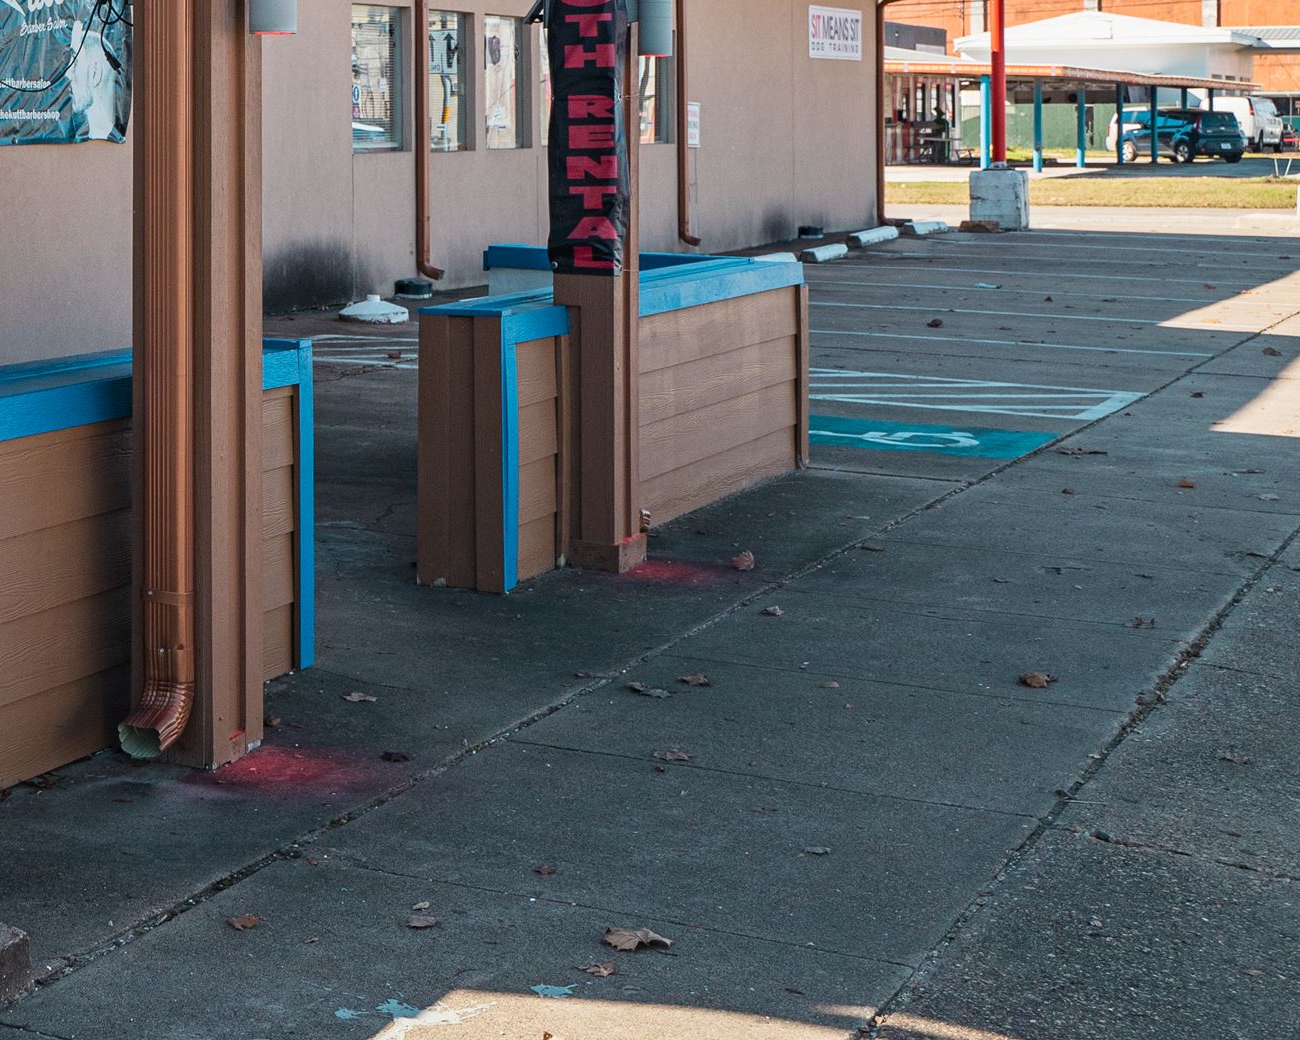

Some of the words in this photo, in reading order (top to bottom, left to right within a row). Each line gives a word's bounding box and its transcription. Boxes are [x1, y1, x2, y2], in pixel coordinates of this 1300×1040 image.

[811, 14, 821, 39] SIT
[822, 15, 849, 41] MEANS
[850, 18, 860, 42] SIT
[567, 95, 618, 268] RENTAL
